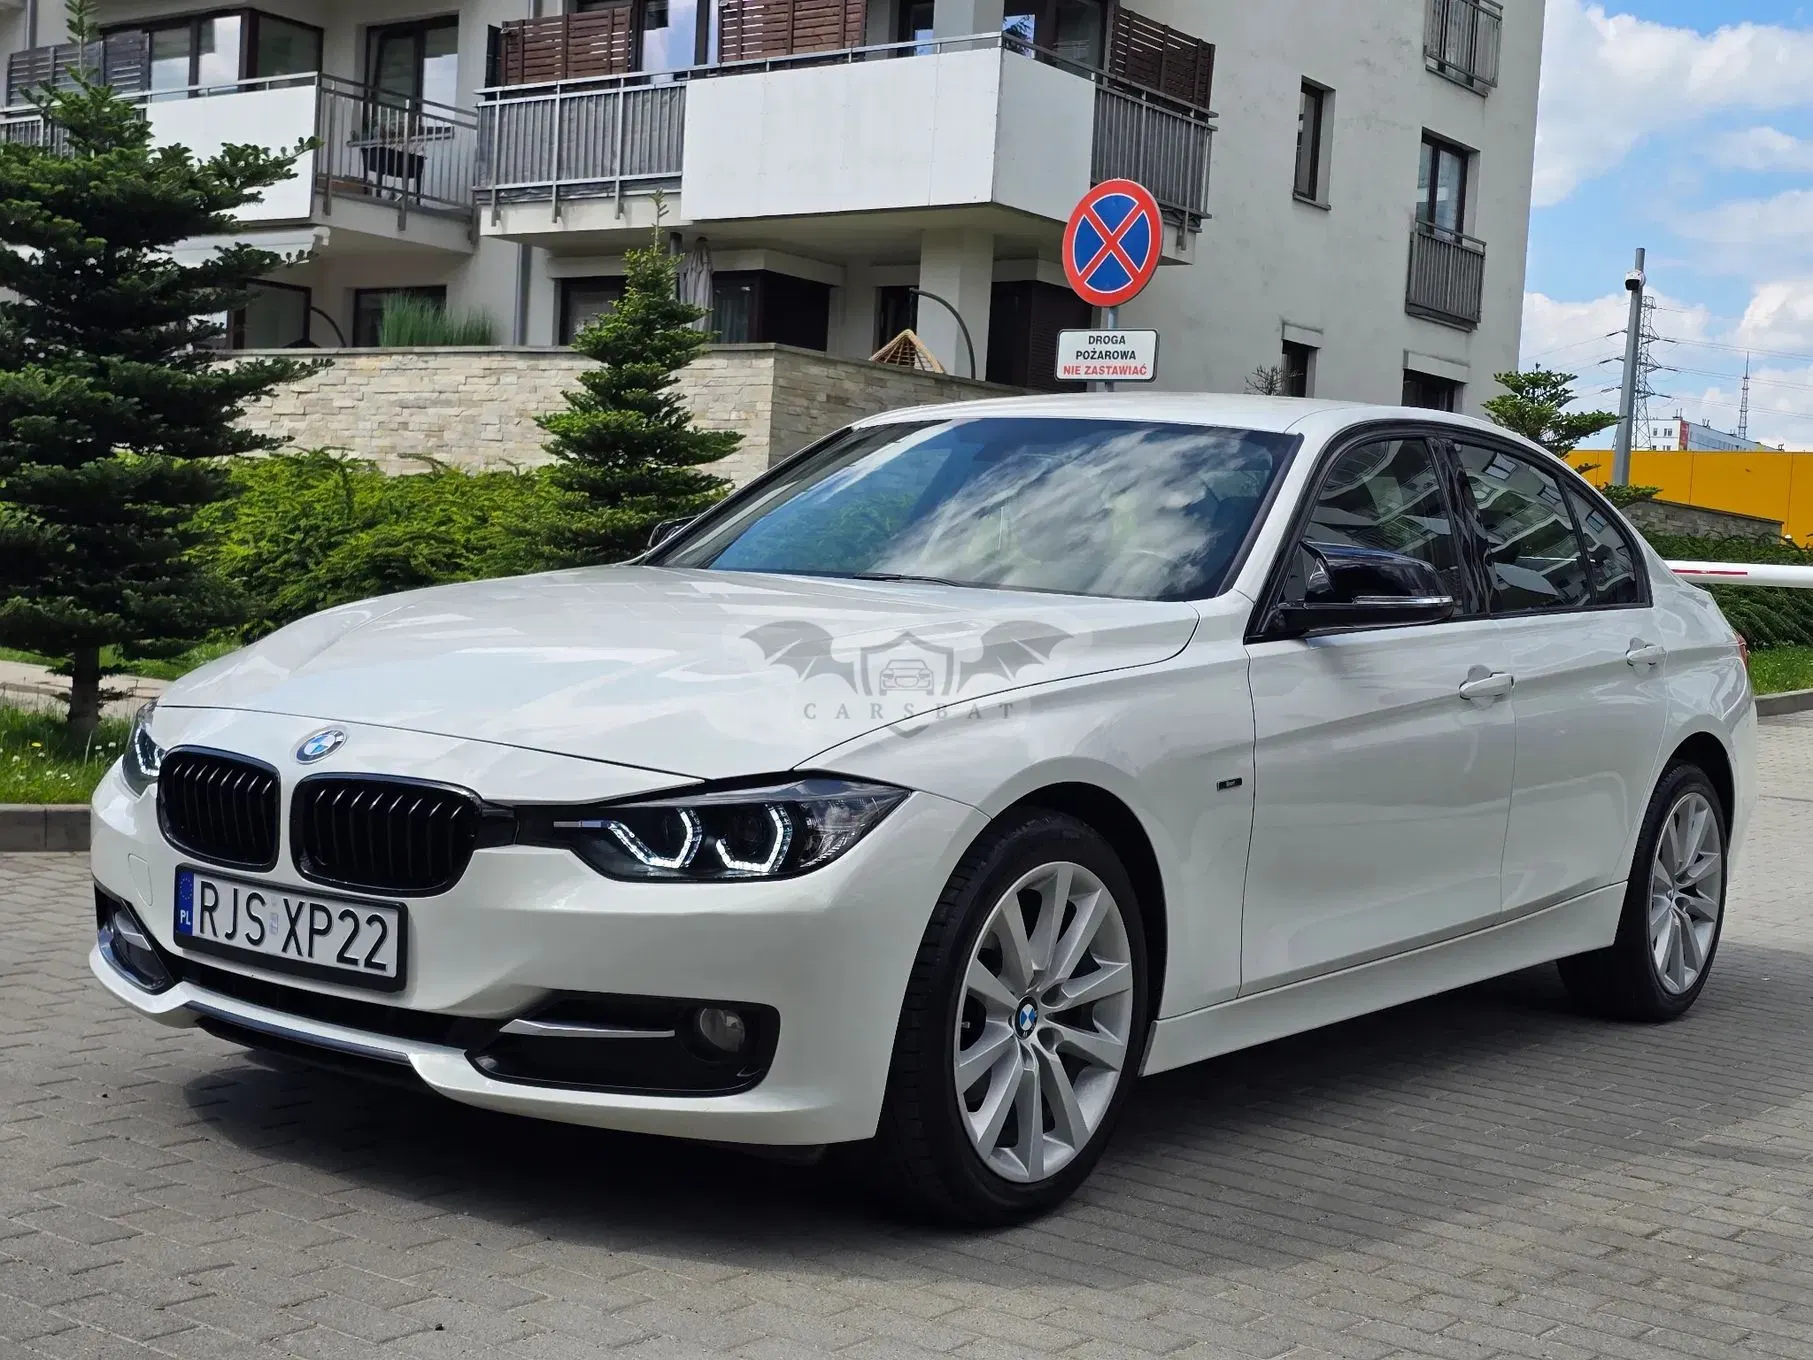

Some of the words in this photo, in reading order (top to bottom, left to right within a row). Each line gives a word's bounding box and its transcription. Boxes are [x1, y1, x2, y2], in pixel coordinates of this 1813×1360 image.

[1088, 335, 1126, 345] DROGA
[1075, 347, 1136, 360] POŻAROWA
[1063, 365, 1081, 375] NIE
[1084, 363, 1148, 375] ZASTAWIAĆ
[179, 909, 191, 926] PL
[200, 880, 266, 946] RJS
[281, 898, 387, 972] XP22
